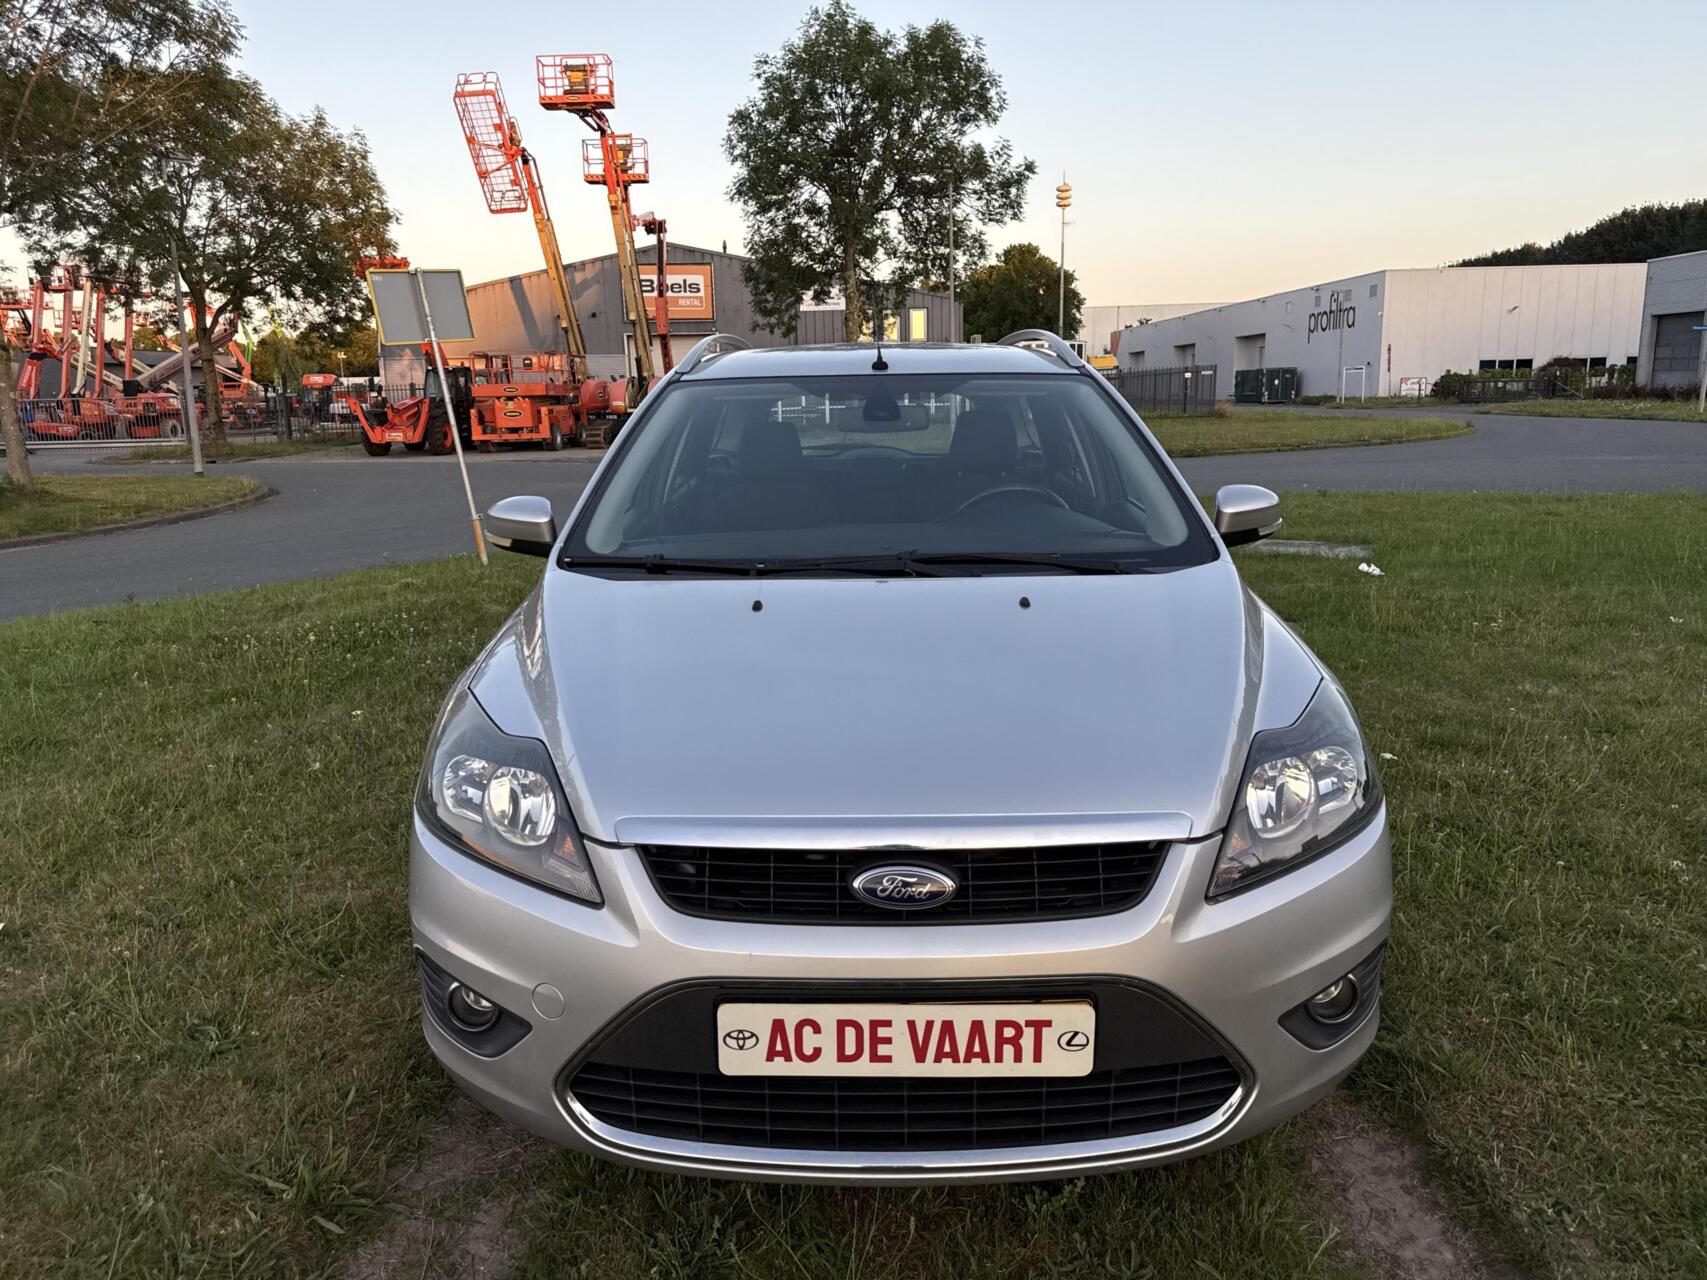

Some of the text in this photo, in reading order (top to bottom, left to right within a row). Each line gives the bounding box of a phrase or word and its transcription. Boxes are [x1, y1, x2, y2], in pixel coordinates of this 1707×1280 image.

[678, 298, 702, 306] RENTAL
[1307, 292, 1356, 344] profiltra
[877, 875, 931, 899] Ford
[765, 1018, 1053, 1064] AC DE VAART
